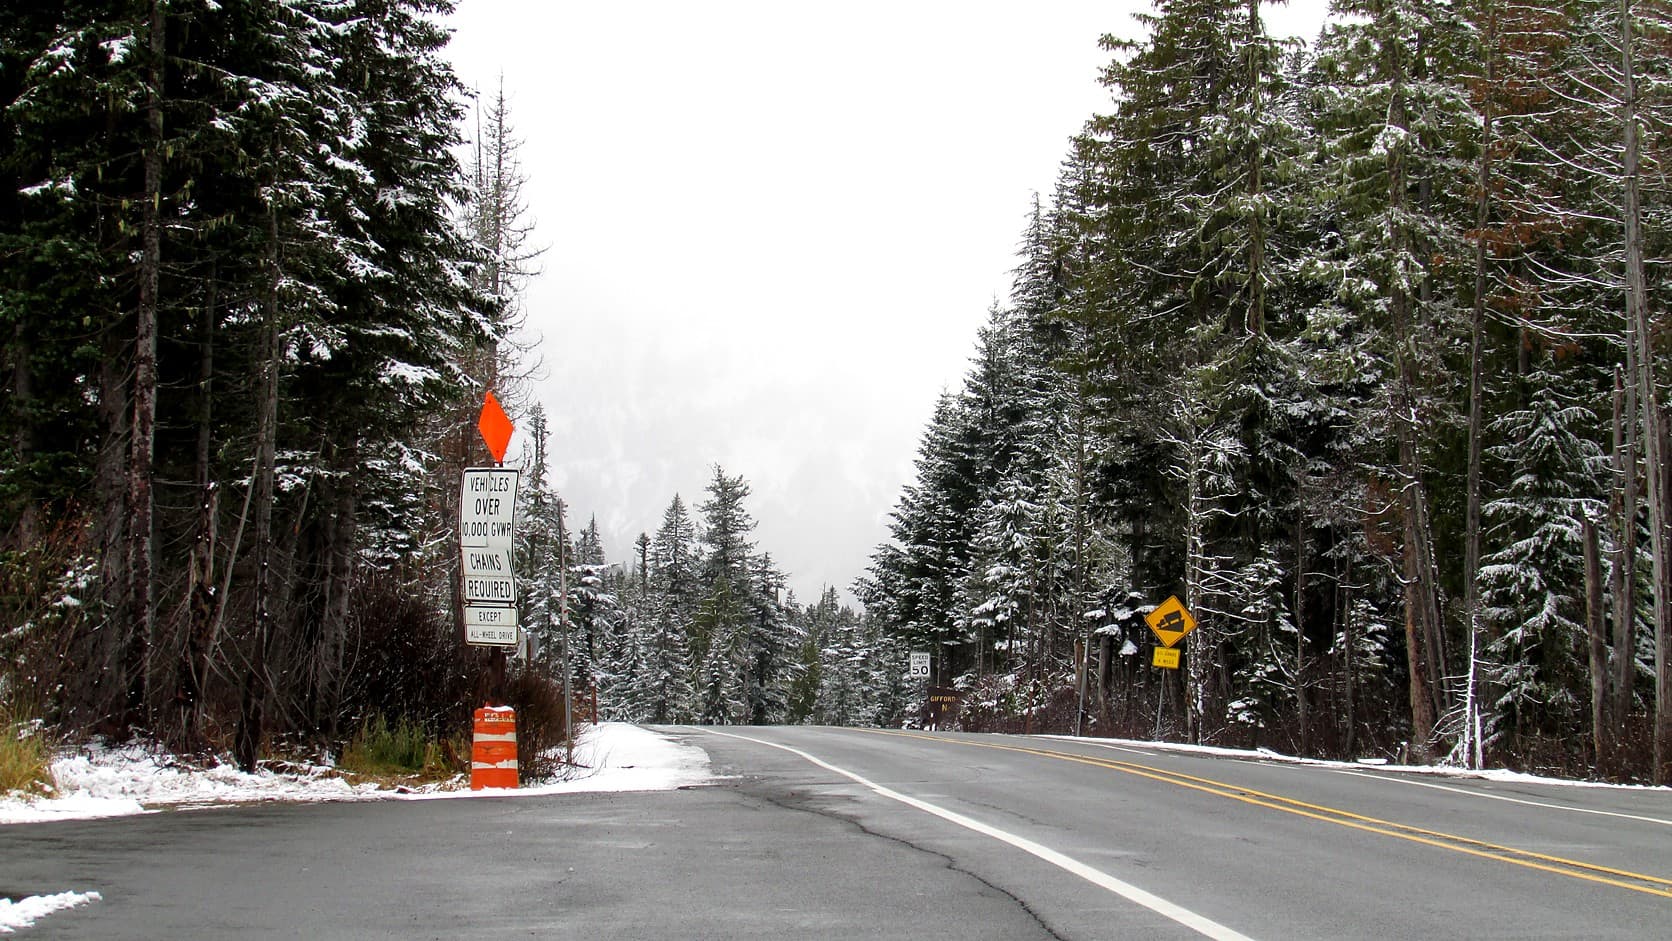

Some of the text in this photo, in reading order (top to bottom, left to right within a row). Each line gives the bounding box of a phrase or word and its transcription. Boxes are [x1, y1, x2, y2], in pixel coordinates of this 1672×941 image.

[470, 477, 509, 492] VEHICLES
[475, 498, 500, 515] OVER
[491, 522, 512, 537] GVWR
[470, 553, 502, 571] CHAINS
[468, 580, 511, 598] REQUIRED
[479, 611, 501, 622] EXCEPT
[471, 630, 513, 640] ALL-WHEEL DRIVE
[912, 666, 928, 675] 50
